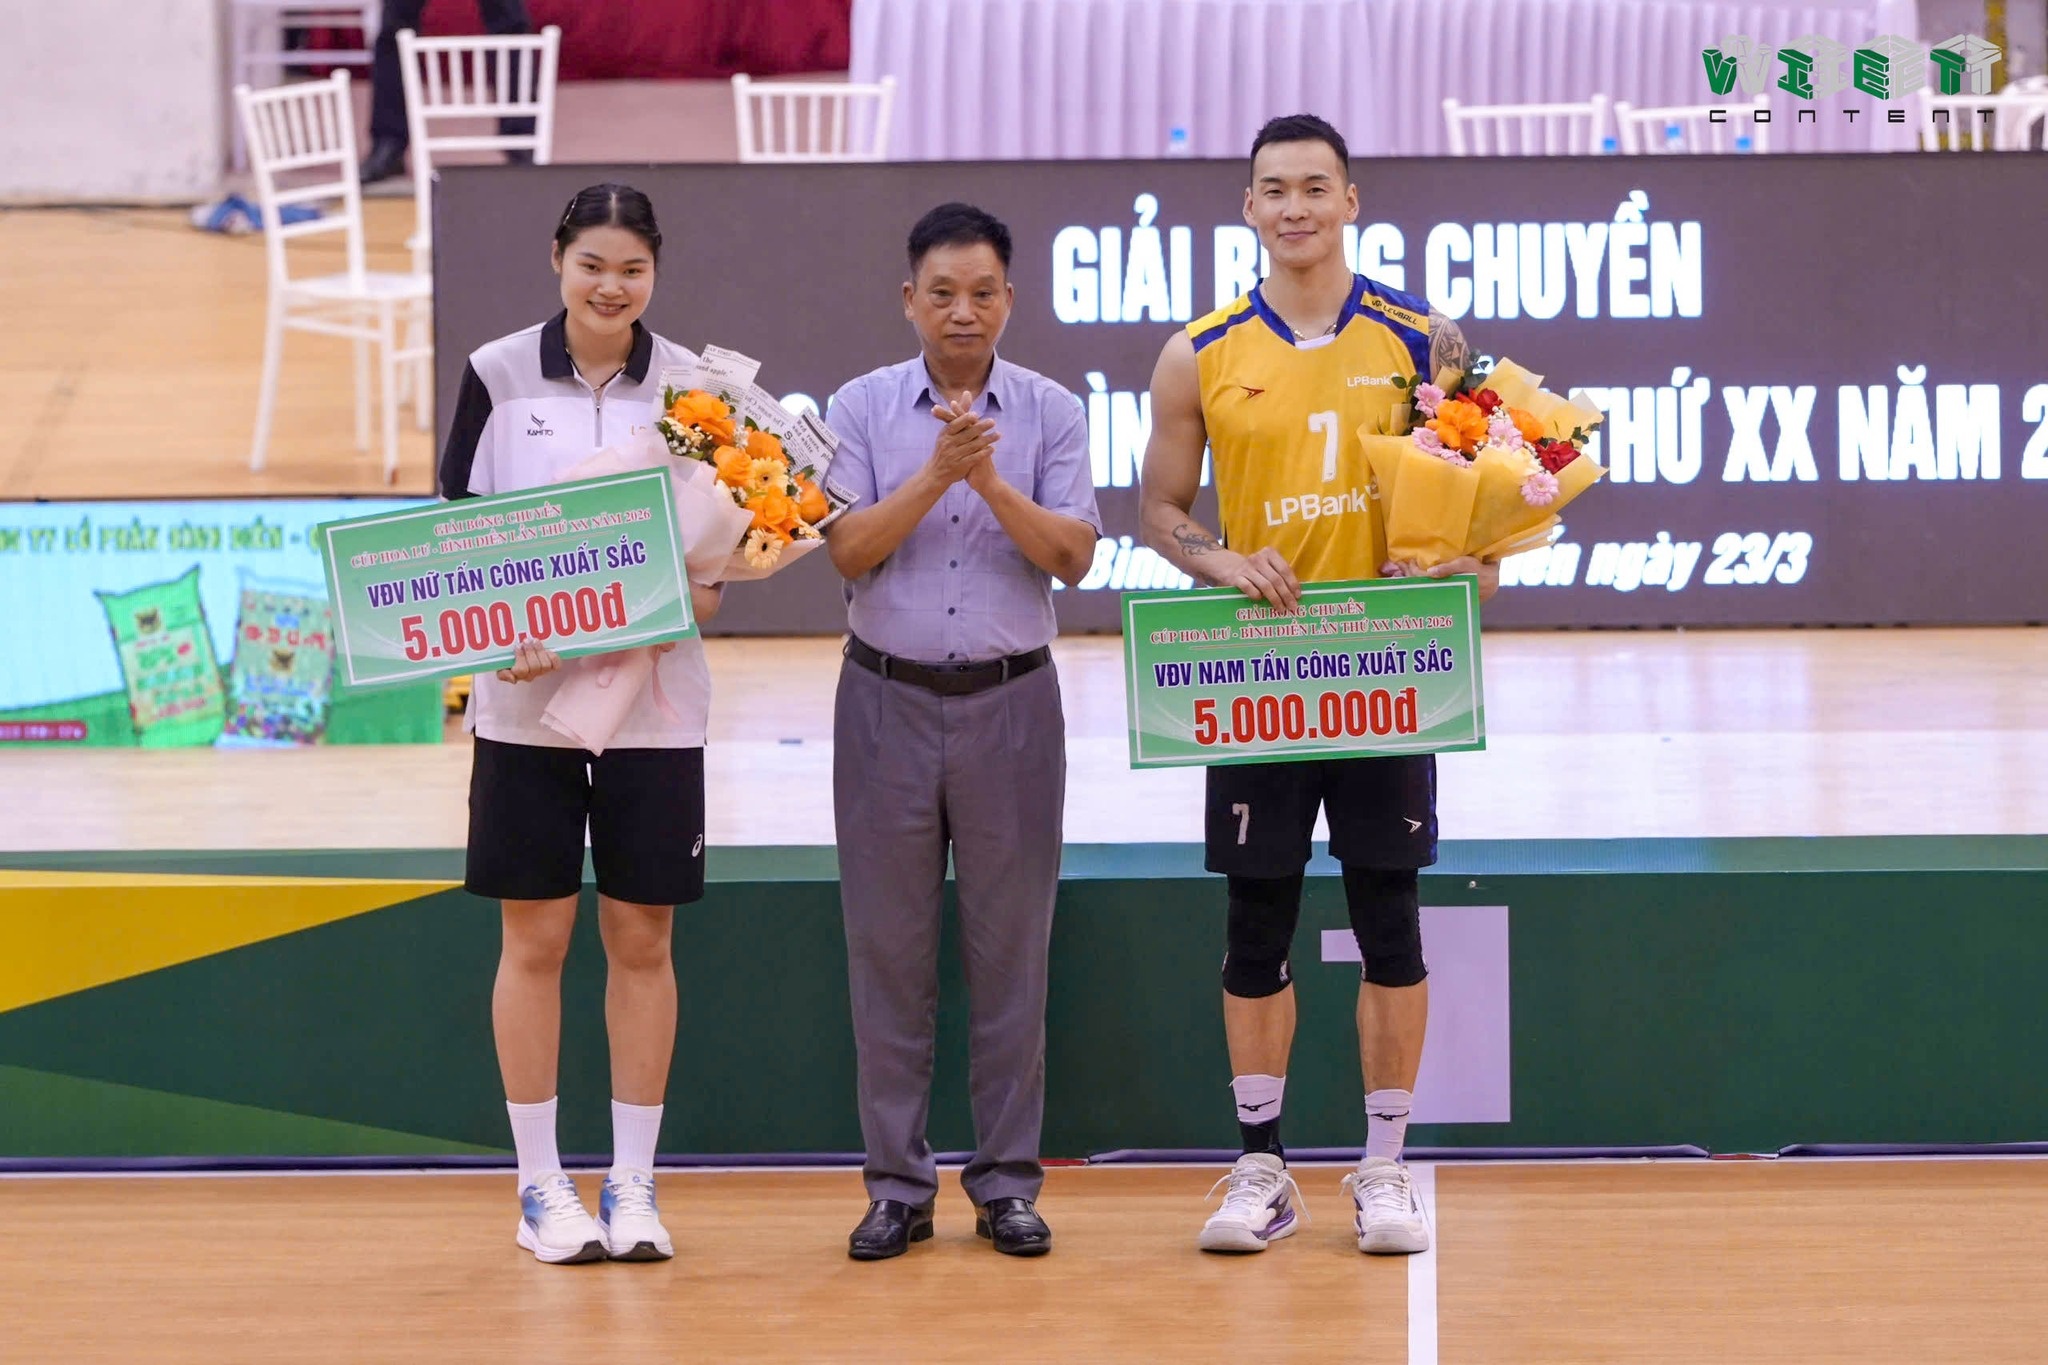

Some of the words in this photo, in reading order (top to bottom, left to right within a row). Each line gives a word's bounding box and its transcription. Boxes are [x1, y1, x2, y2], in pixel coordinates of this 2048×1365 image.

[1052, 193, 1192, 323] GIẢI
[1214, 223, 1405, 312] BG
[1425, 189, 1702, 320] CHUYỀN
[1347, 375, 1391, 388] LPBank
[1308, 410, 1338, 482] 7
[1722, 385, 1818, 482] XX
[1838, 364, 2001, 481] NĂM
[466, 514, 504, 531] BÓNG
[1264, 487, 1368, 527] LPBank
[351, 552, 378, 568] CÚP
[380, 548, 410, 564] HOA
[570, 518, 590, 532] XX
[592, 512, 622, 527] NĂM
[625, 508, 651, 523] 2026
[1585, 531, 1702, 592] ngày
[1703, 531, 1813, 585] 23/3
[367, 581, 405, 608] VĐV
[411, 571, 440, 601] NỮ
[444, 561, 485, 595] TẤN
[490, 558, 545, 588] CÔNG
[549, 542, 600, 578] XUẤT
[606, 535, 646, 569] SẮC
[400, 581, 628, 662] 5.000.000đ
[1150, 628, 1177, 644] CÚP
[1180, 629, 1209, 642] HOA
[1212, 627, 1231, 641] LƯ
[1240, 624, 1273, 639] BÌNH
[1371, 619, 1390, 632] XX
[1392, 615, 1424, 630] NĂM
[1426, 616, 1453, 629] 2026
[1236, 604, 1266, 621] GIẢI
[1154, 662, 1192, 687] VĐV
[1198, 660, 1245, 685] NAM
[1251, 650, 1290, 682] TẤN
[1295, 650, 1351, 679] CÔNG
[1356, 642, 1407, 676] XUẤT
[1413, 639, 1453, 672] SẮC
[1193, 687, 1419, 746] 5.000.000đ
[1233, 803, 1249, 845] 7
